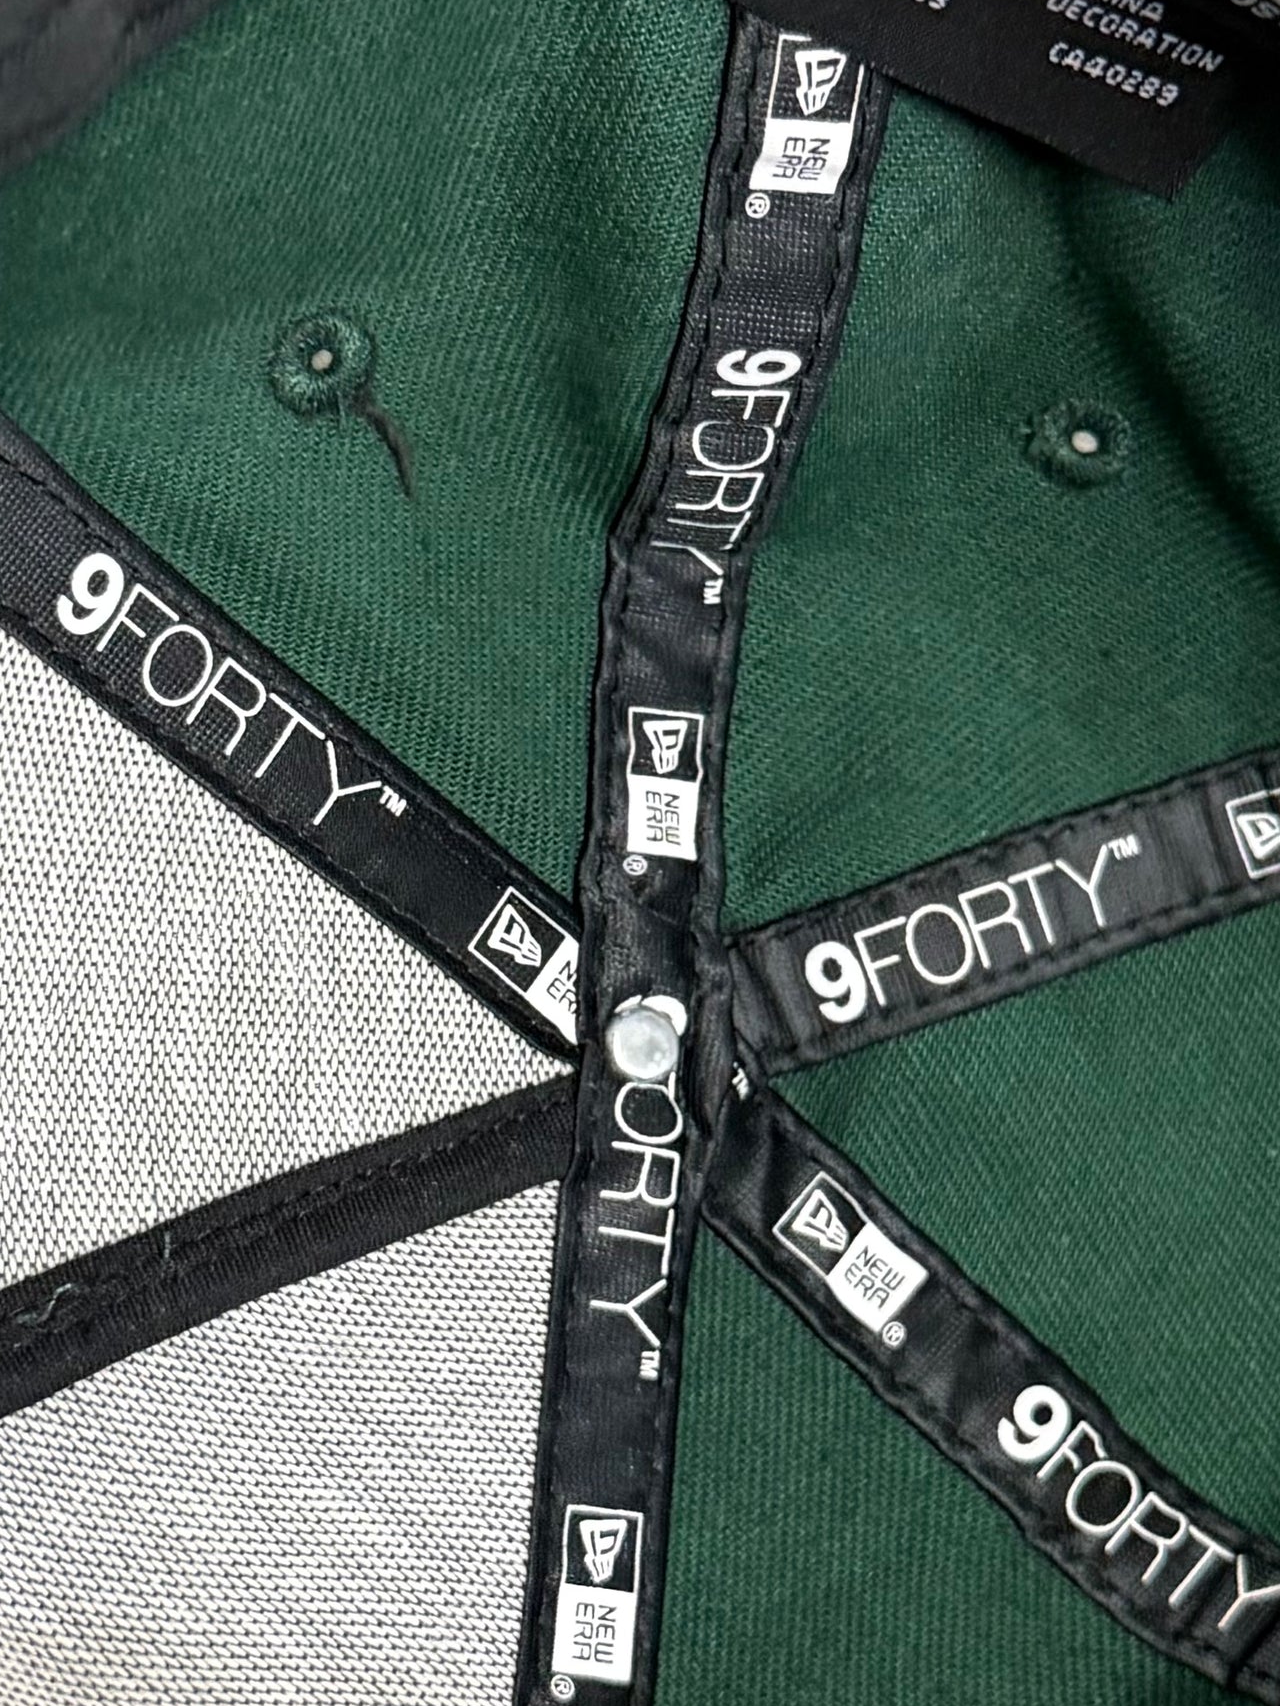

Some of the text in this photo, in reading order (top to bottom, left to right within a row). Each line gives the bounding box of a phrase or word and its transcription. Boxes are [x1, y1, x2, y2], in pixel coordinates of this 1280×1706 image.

[1048, 42, 1180, 107] CA40289
[772, 136, 806, 179] ERA
[797, 137, 831, 181] NEW
[645, 790, 664, 843] ERA
[663, 792, 682, 846] NEW
[546, 977, 577, 1014] ER
[844, 1262, 890, 1310] ERA
[855, 1244, 906, 1291] NEW
[571, 1601, 595, 1661] ERA
[594, 1604, 618, 1664] NEW
